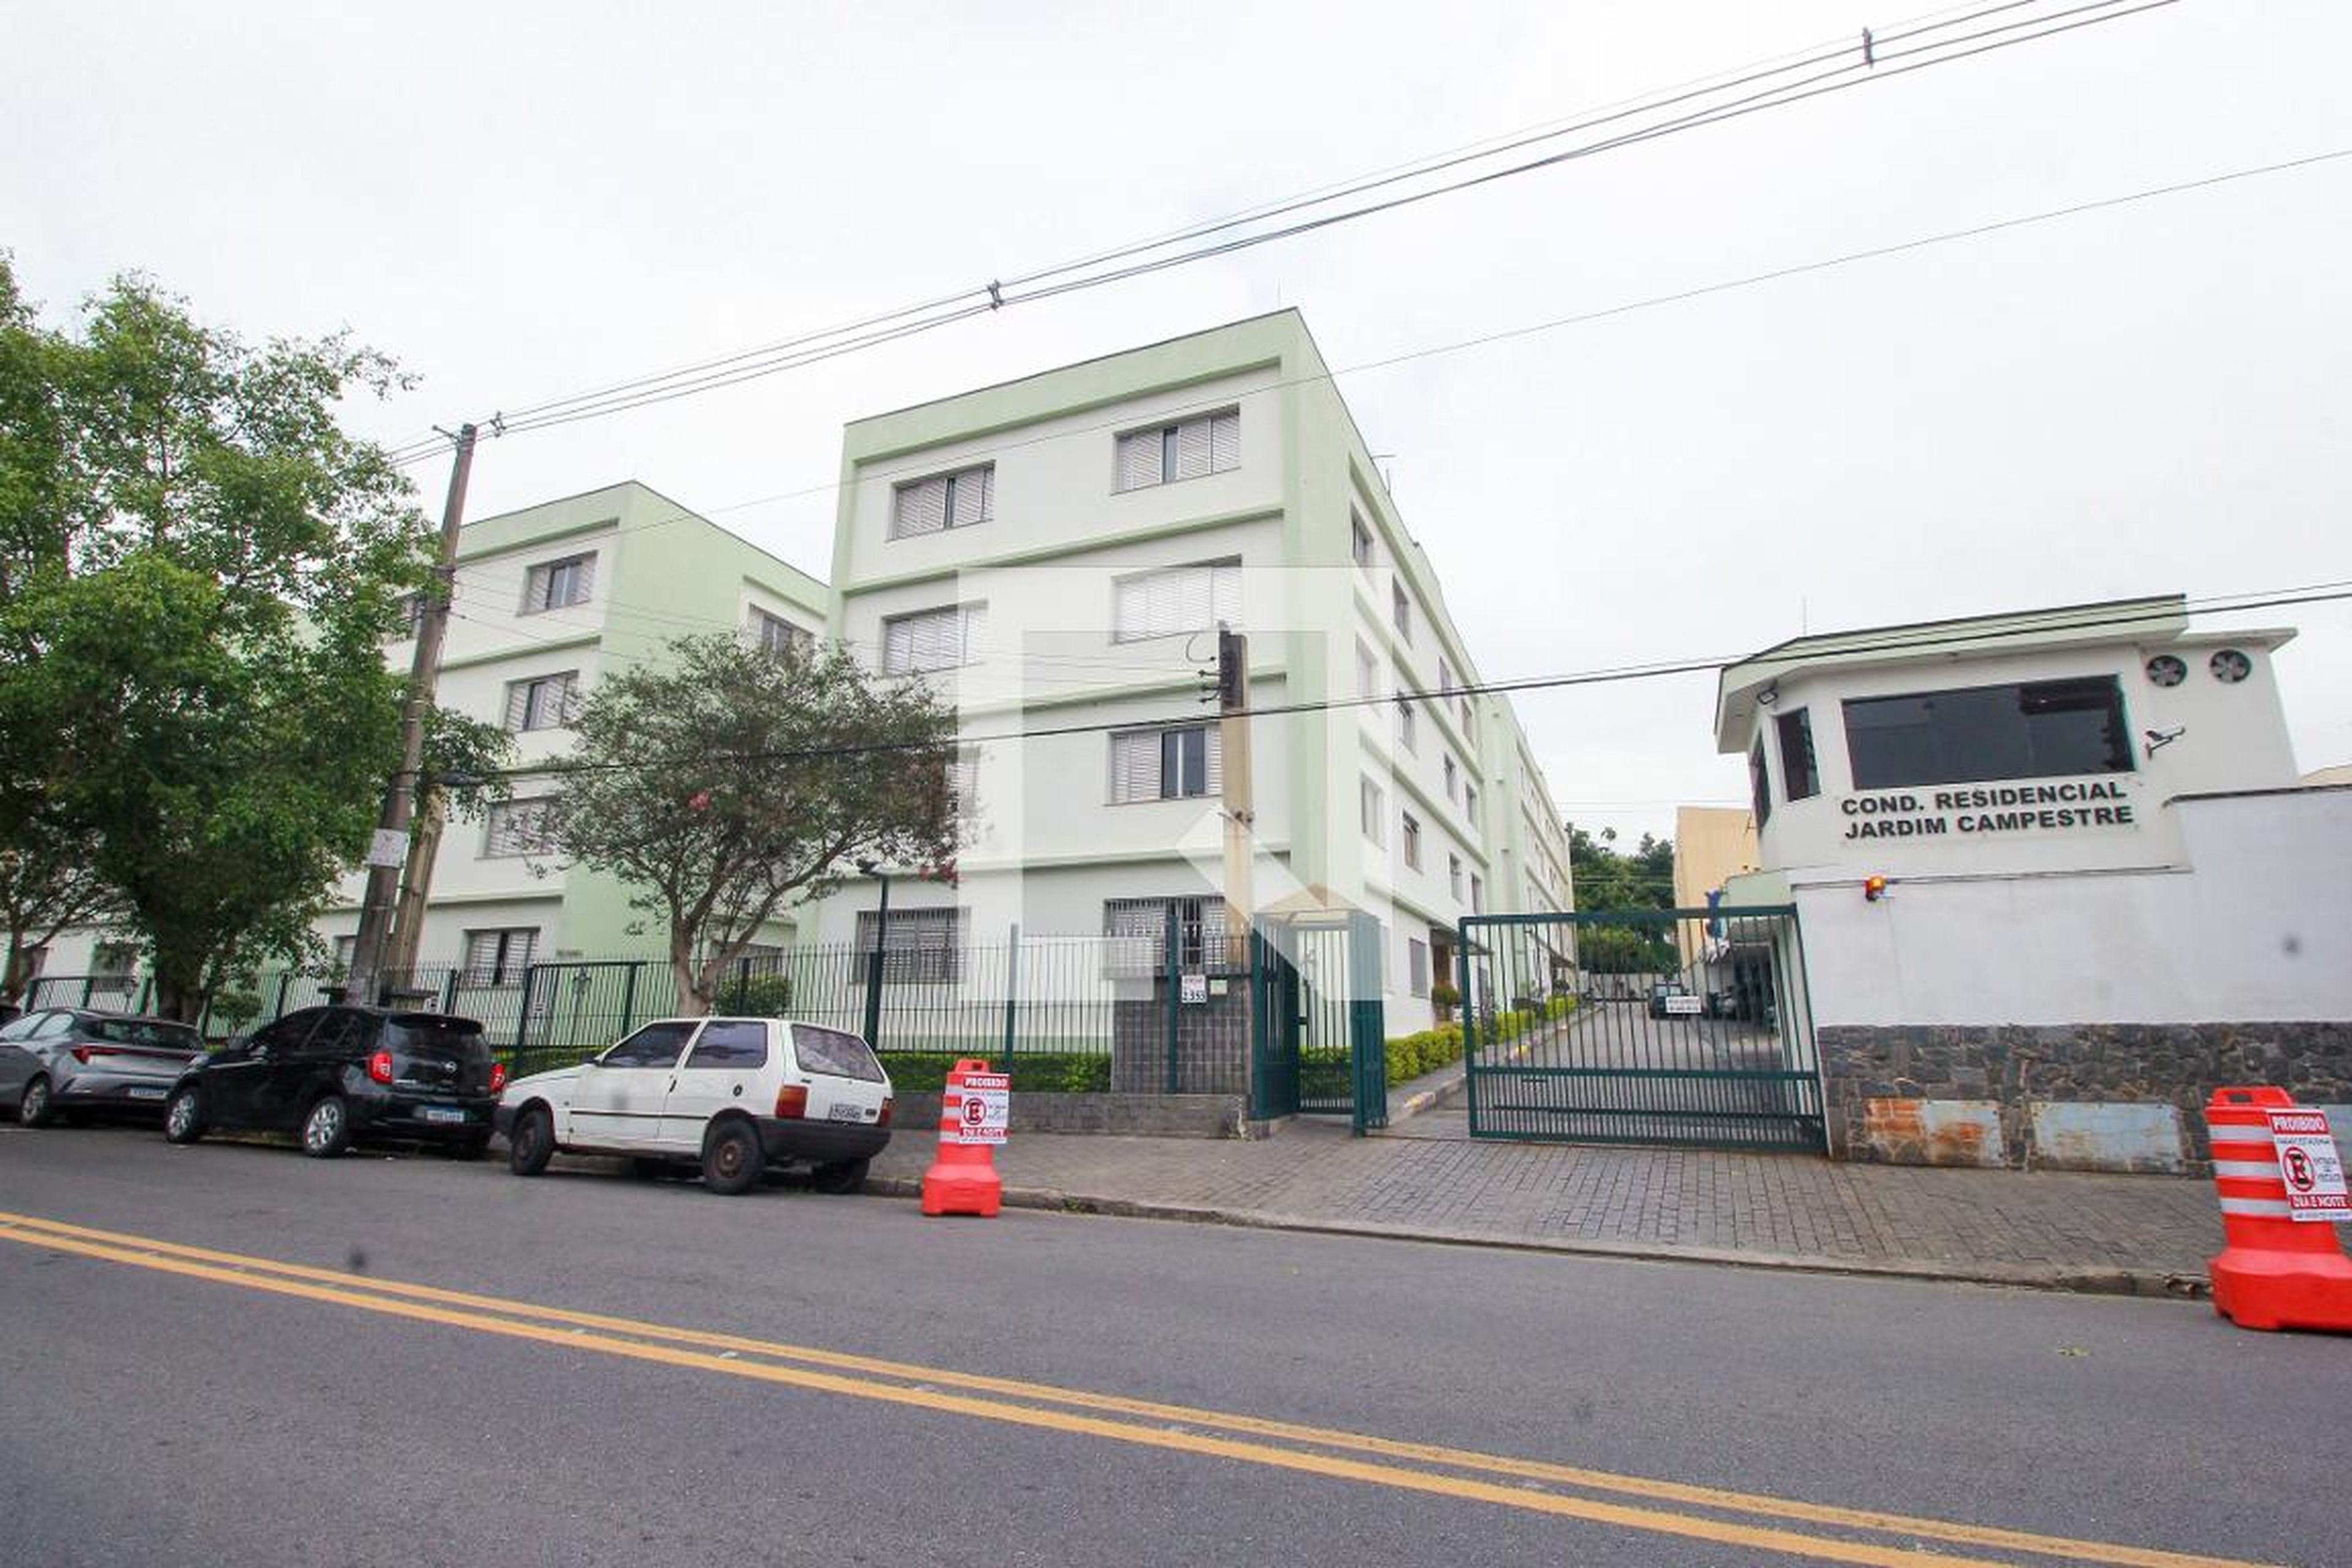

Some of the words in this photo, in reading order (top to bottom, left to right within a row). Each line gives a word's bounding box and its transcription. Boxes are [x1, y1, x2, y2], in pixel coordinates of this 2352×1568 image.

[1841, 796, 1925, 815] COND.
[1936, 782, 2127, 810] RESIDENCIAL
[1845, 816, 1947, 839] JARDIM
[1957, 805, 2134, 832] CAMPESTRE
